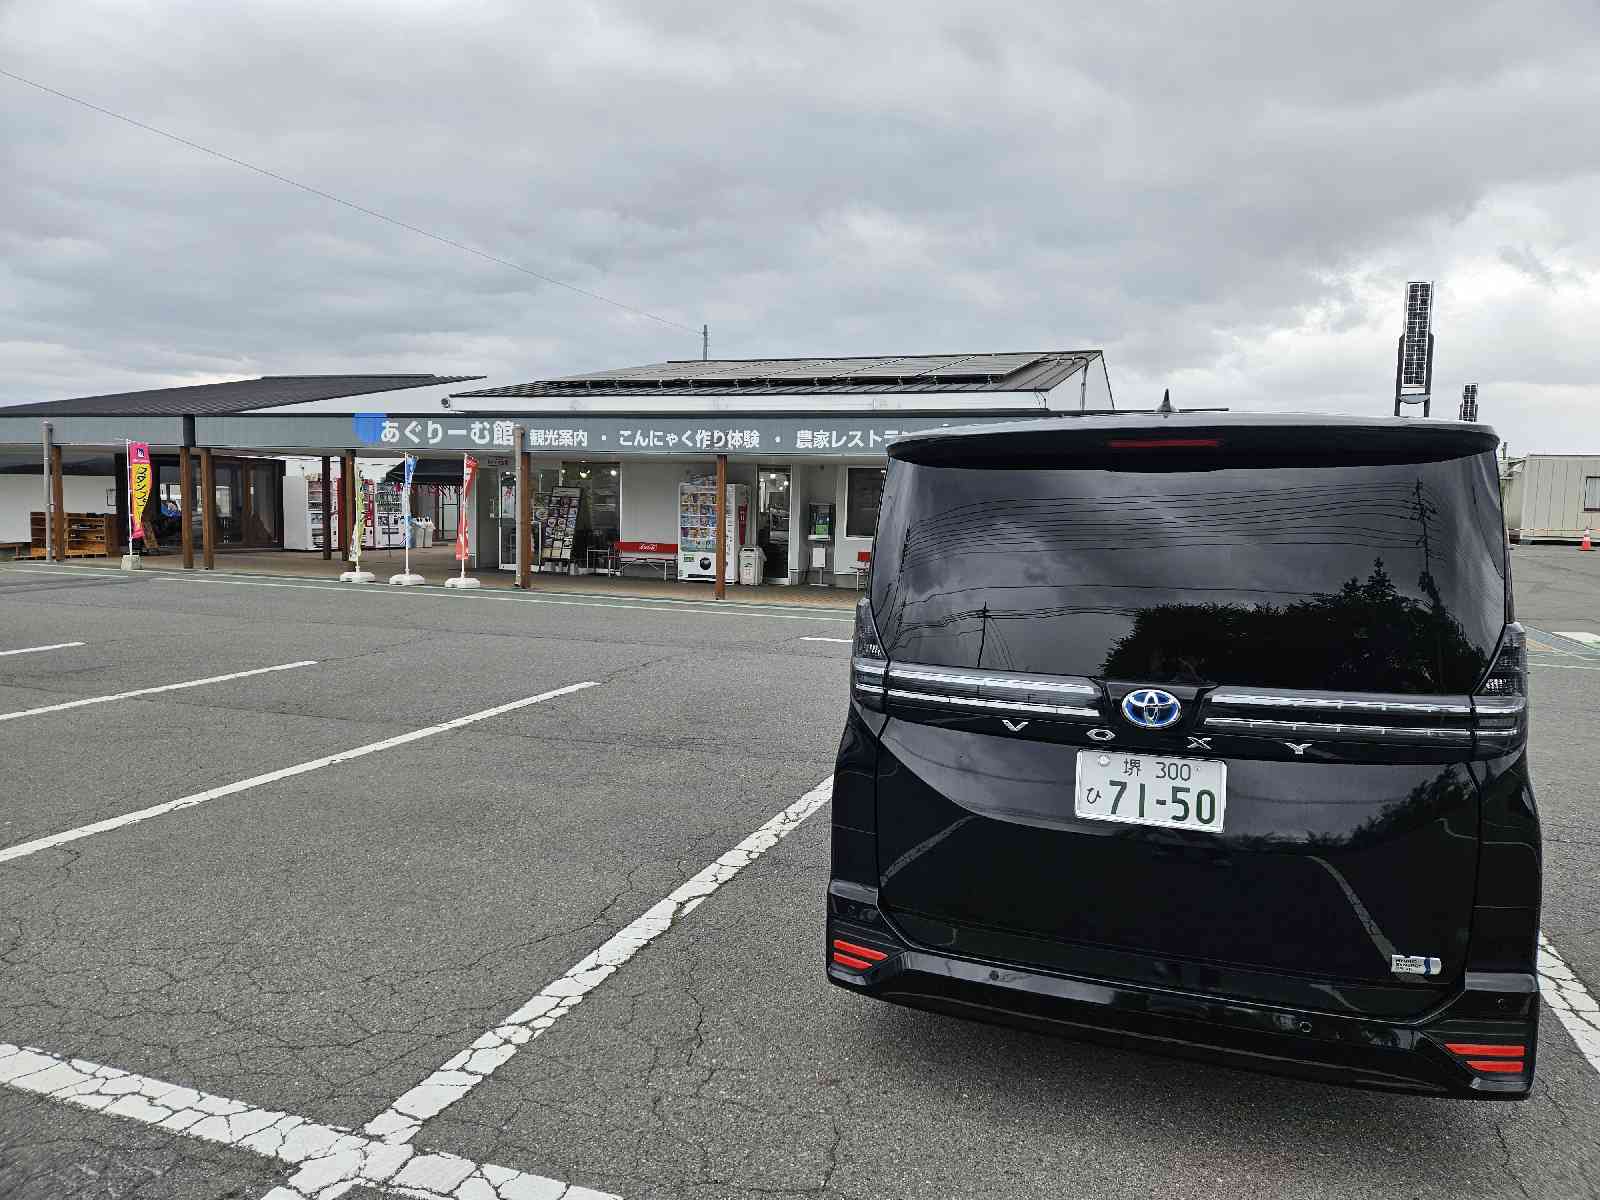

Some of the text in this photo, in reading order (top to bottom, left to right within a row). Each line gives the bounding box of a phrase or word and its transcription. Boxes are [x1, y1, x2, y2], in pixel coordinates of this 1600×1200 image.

[380, 420, 514, 445] あぐりーむ館
[529, 429, 588, 447] 観光案内
[619, 429, 760, 449] こんにゃく作り体験
[795, 429, 913, 449] 農家レストラ
[1002, 719, 1312, 754] VOXY
[1123, 758, 1191, 781] 堺 300
[1086, 779, 1216, 825] ひ 71-50
